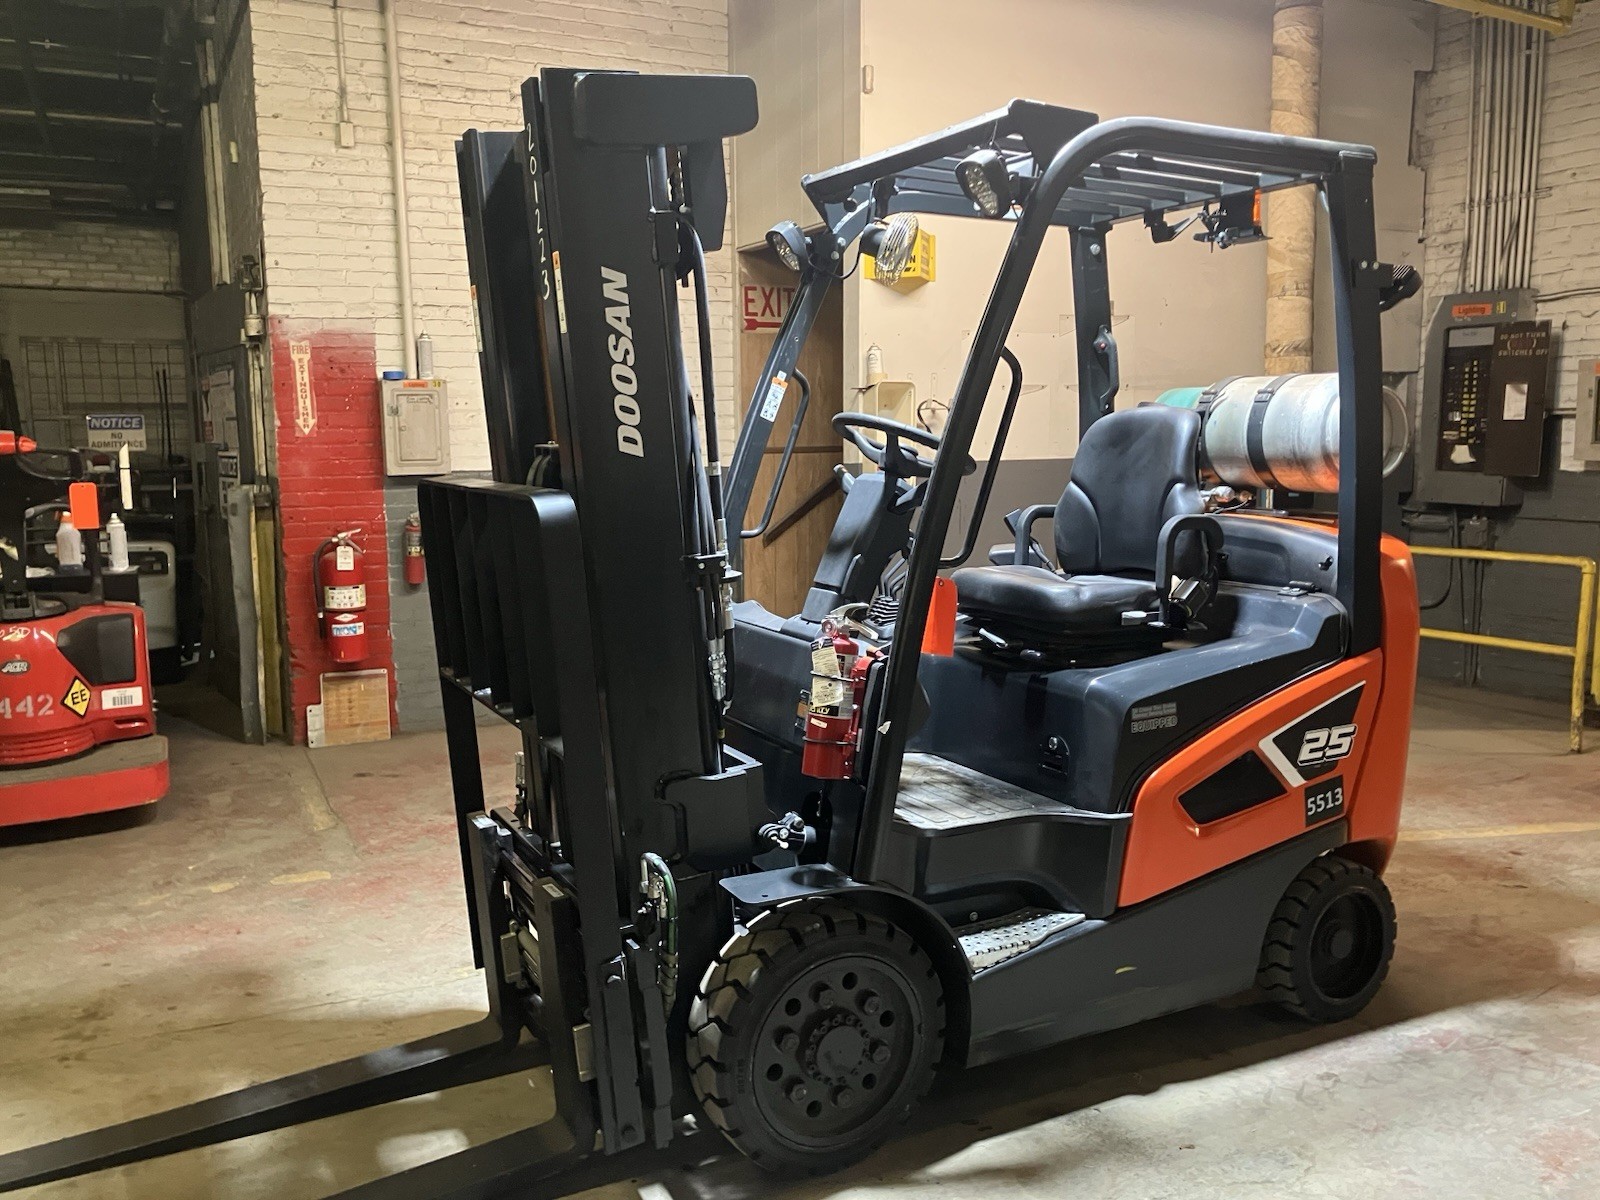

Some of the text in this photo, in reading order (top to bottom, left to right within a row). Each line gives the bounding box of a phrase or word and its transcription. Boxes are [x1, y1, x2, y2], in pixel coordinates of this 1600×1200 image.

[743, 285, 796, 318] EXIT
[291, 344, 310, 355] FIRE
[601, 265, 645, 458] DOOSAN
[297, 357, 310, 430] EXTINGUISHER
[90, 417, 142, 429] NOTICE
[110, 432, 123, 440] NO
[70, 688, 89, 706] EE
[1130, 714, 1179, 734] EQUIPPED
[1297, 723, 1358, 767] 25
[1307, 787, 1343, 816] 5513
